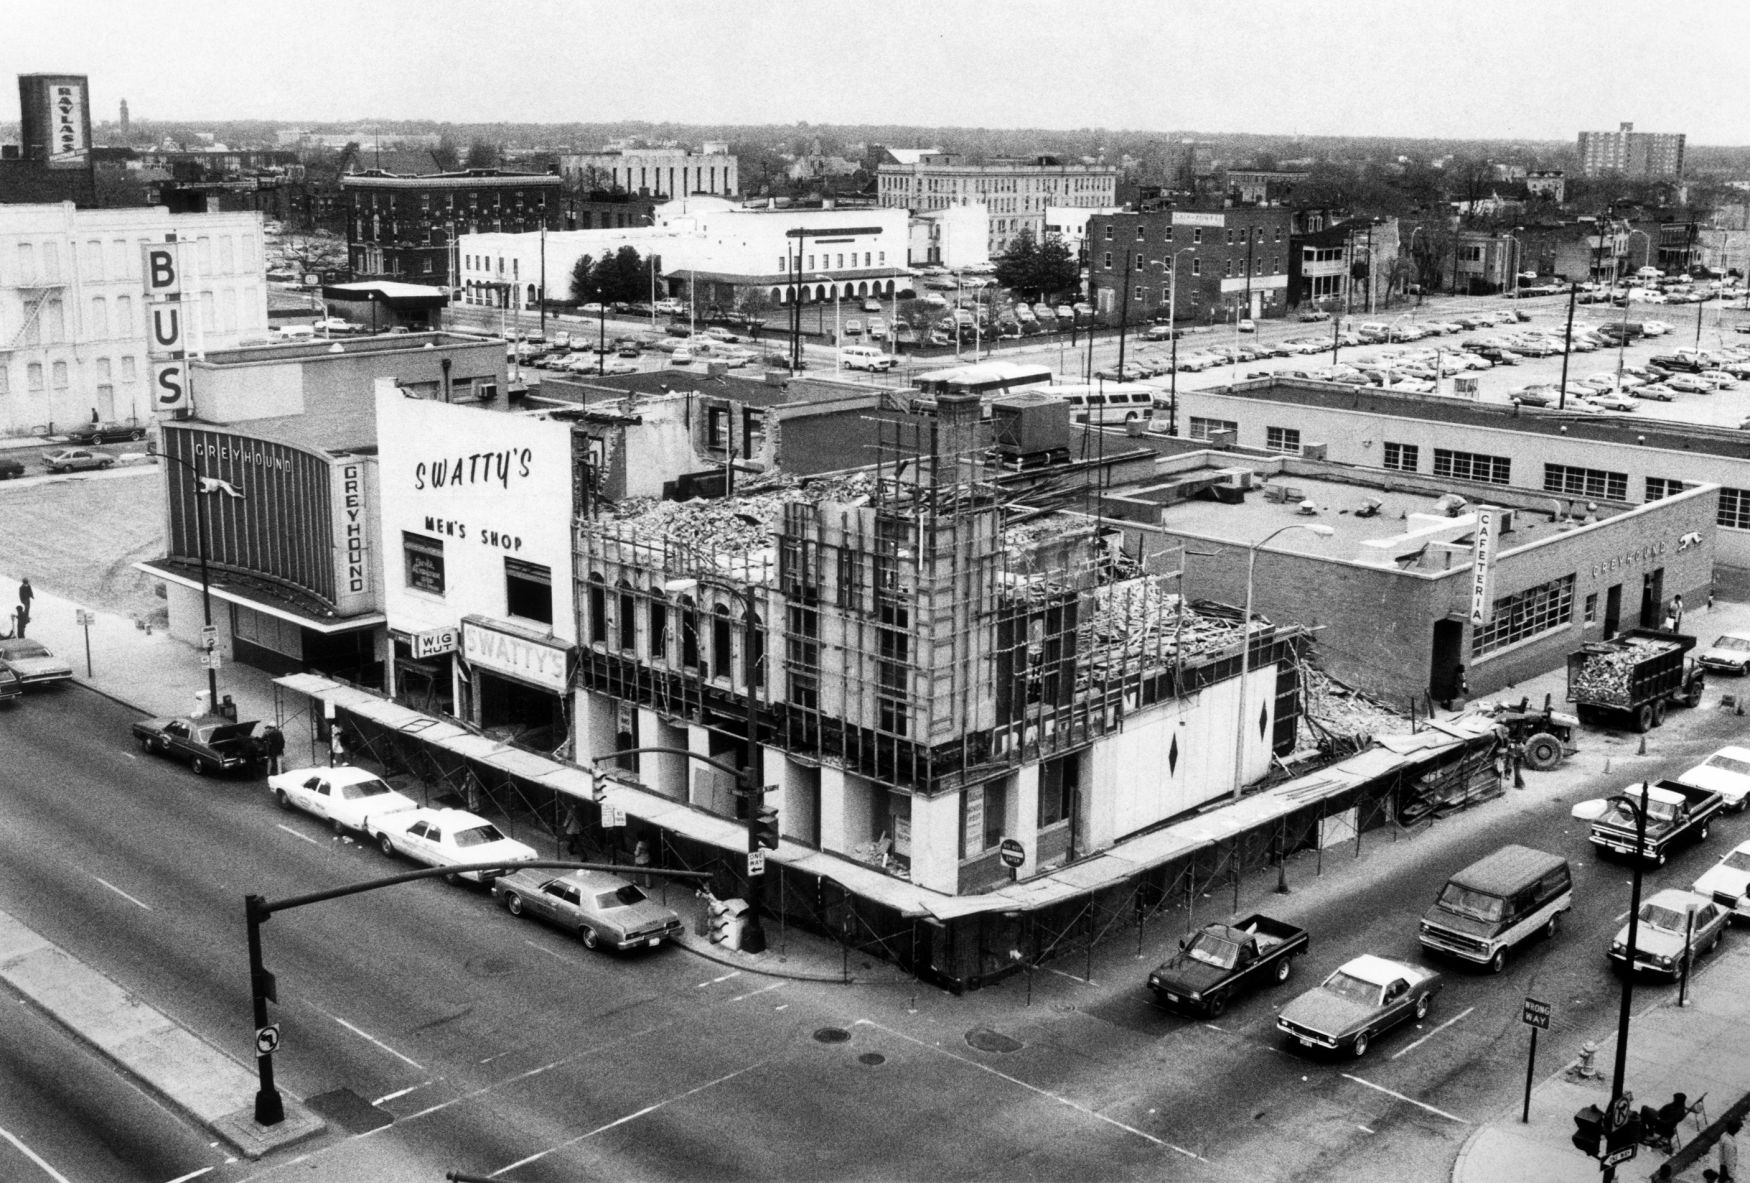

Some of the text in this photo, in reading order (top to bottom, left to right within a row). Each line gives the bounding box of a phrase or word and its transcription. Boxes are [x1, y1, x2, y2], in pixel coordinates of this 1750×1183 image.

[150, 250, 182, 404] BUS
[195, 443, 292, 473] GREYHOUND
[415, 447, 532, 490] SWATTY'S
[344, 466, 364, 593] GREYHOUND
[425, 515, 522, 551] MEN'S SHOP
[1472, 514, 1490, 620] CAFETERIA
[1591, 541, 1667, 579] GREYHOUND
[423, 633, 452, 647] WIG
[423, 644, 452, 656] HUT
[466, 627, 564, 678] SWATTY'S
[749, 852, 763, 860] ONE
[1525, 1001, 1550, 1016] WRONG
[1525, 1011, 1547, 1025] WAY
